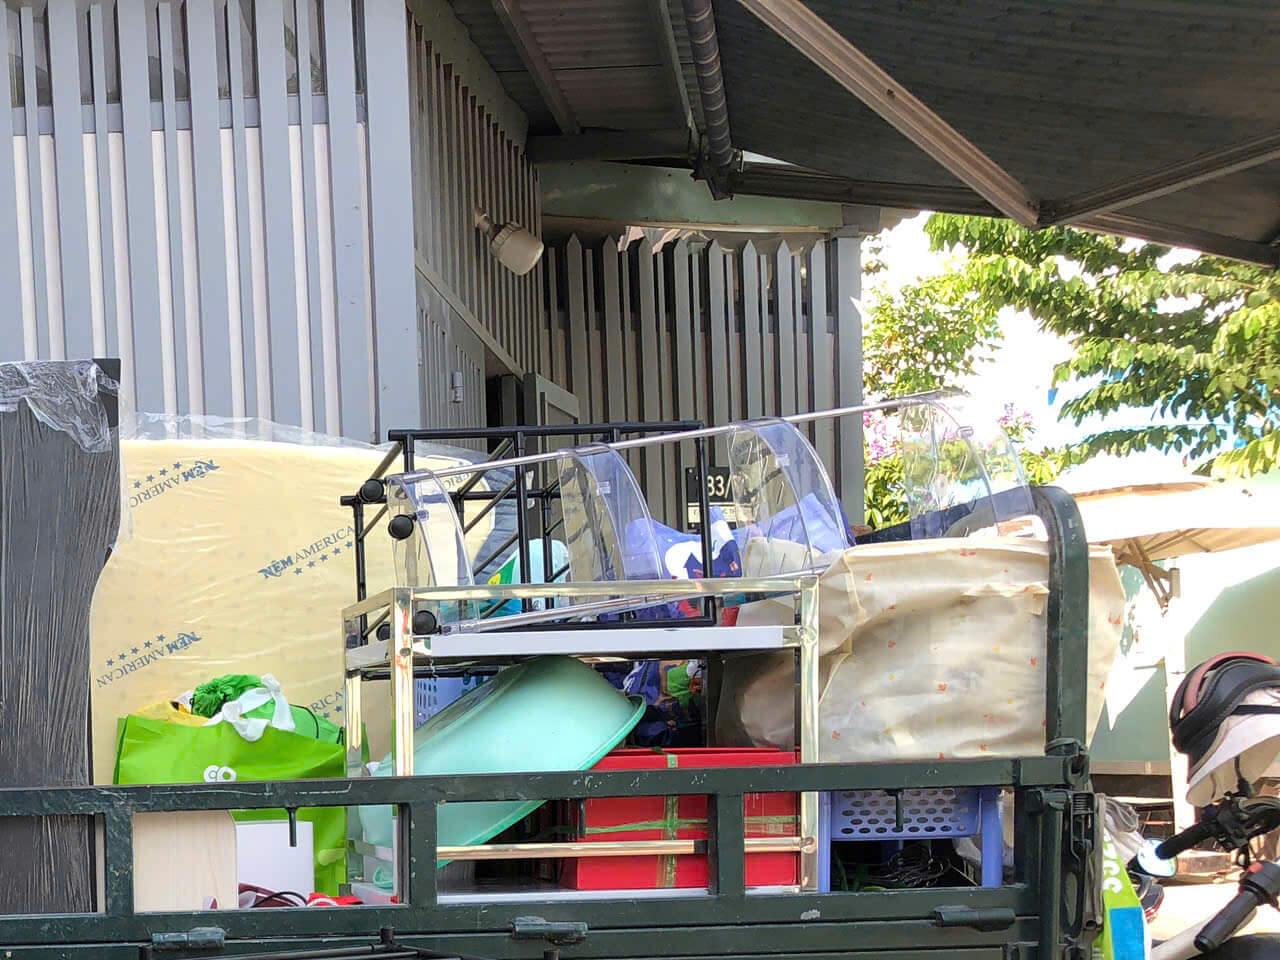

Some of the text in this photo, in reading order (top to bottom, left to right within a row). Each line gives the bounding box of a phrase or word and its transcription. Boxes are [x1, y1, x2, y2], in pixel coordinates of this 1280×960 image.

[129, 474, 181, 508] AMERIC
[295, 525, 355, 563] AMERICA
[95, 646, 165, 688] AMERICAN
